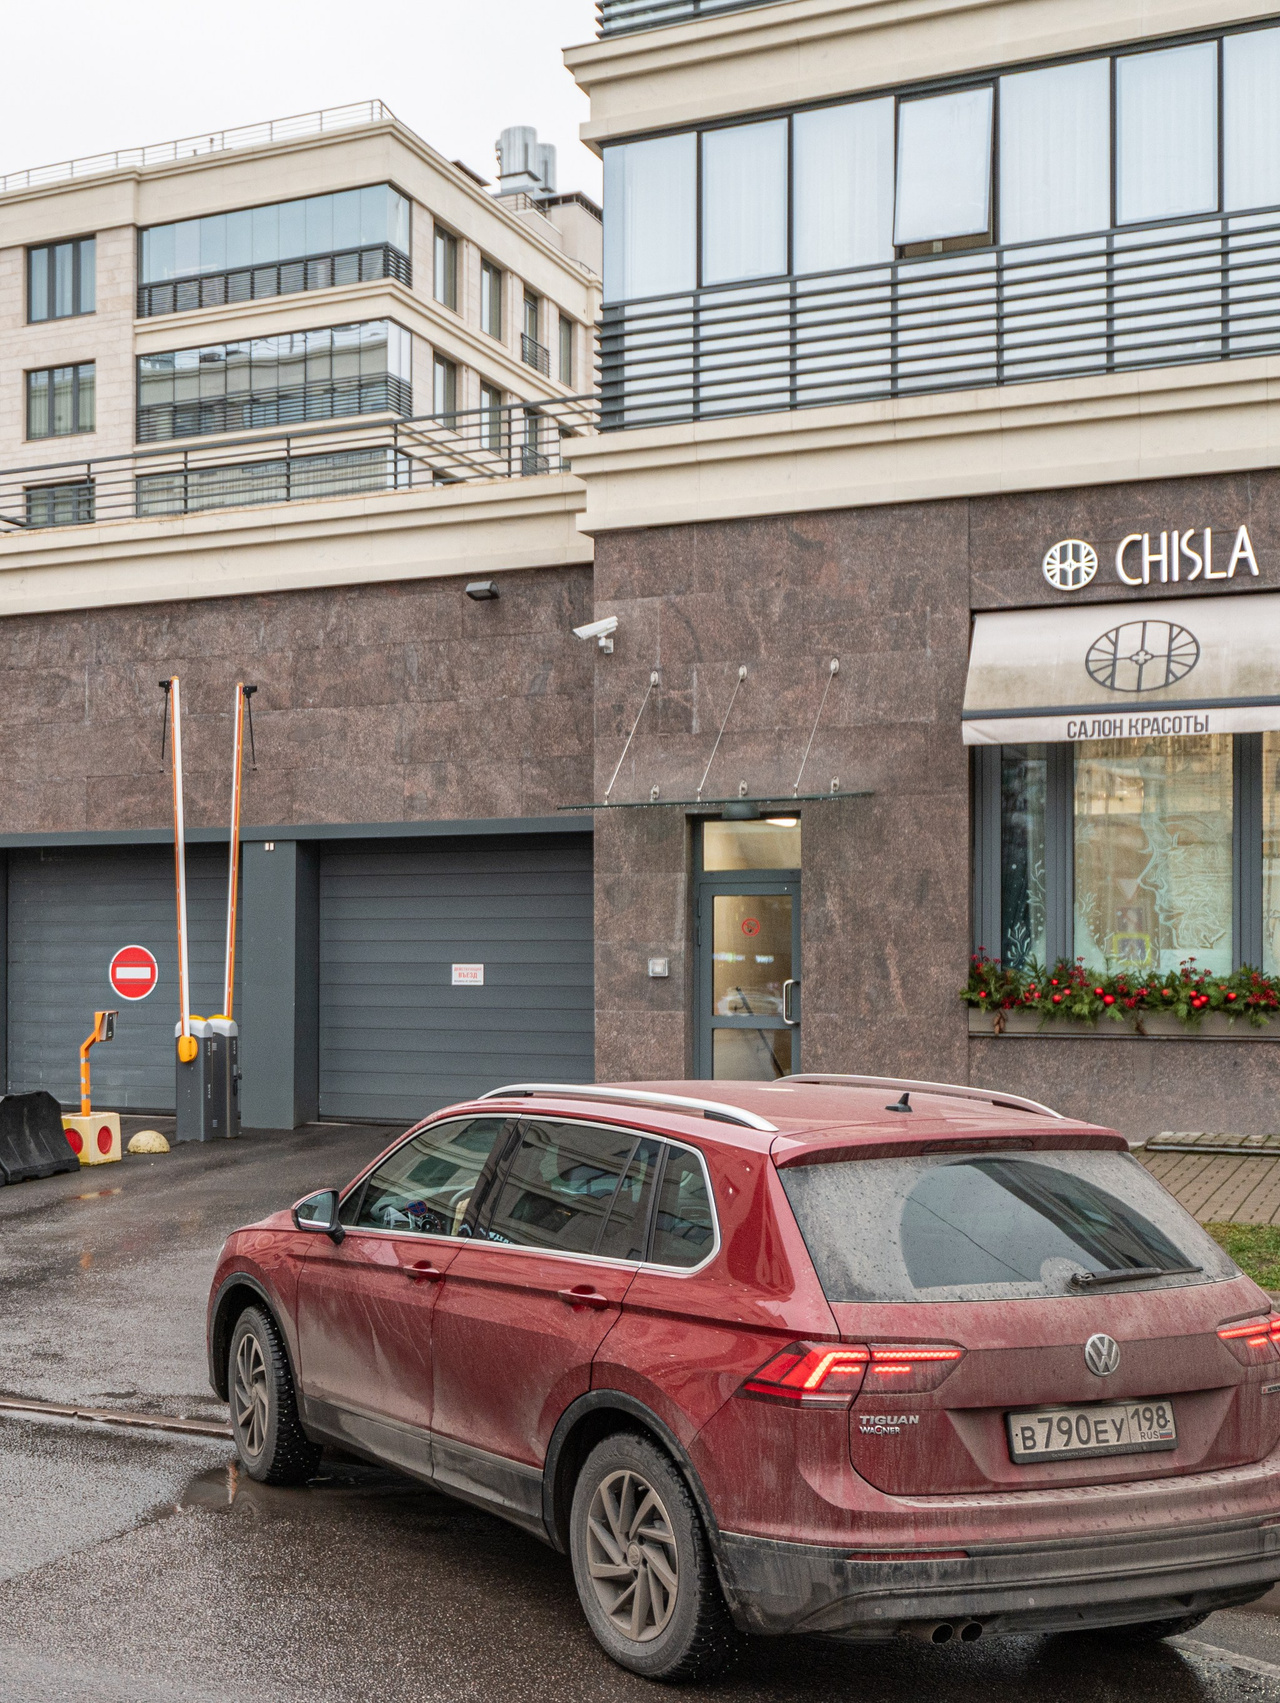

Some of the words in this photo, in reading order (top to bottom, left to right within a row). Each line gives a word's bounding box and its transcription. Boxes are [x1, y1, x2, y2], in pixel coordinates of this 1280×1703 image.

[1115, 524, 1260, 586] CHISLA
[1067, 719, 1123, 739] САЛОН
[1128, 714, 1210, 736] КРАСОТЫ
[859, 1415, 920, 1425] TIGUAN
[1130, 1405, 1169, 1432] 198
[859, 1425, 901, 1436] WAGNER
[1140, 1430, 1159, 1440] RUS
